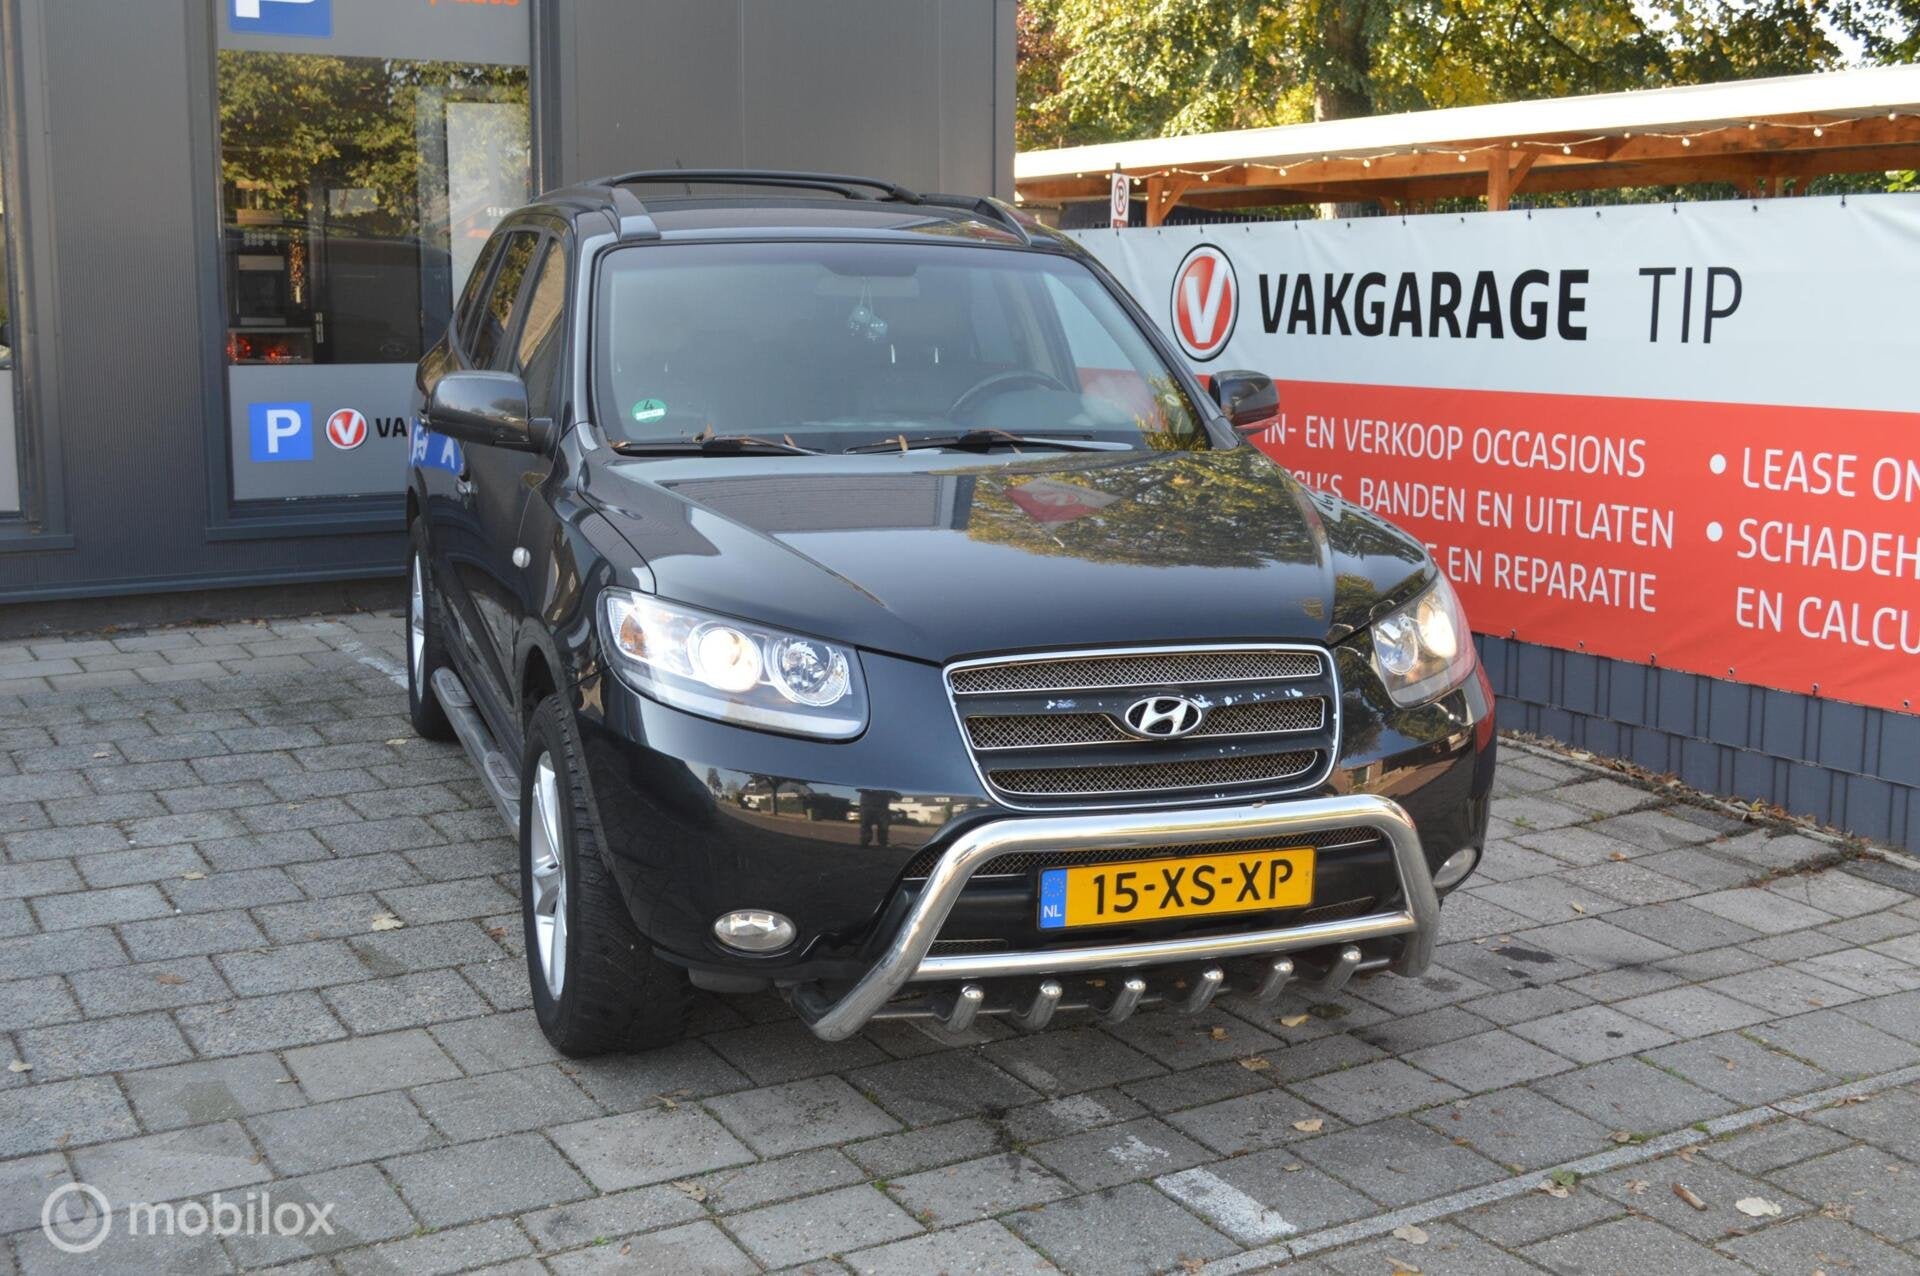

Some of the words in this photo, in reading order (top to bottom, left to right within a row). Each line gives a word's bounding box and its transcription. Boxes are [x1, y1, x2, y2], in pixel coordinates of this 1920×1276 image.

[1258, 268, 1590, 341] VAKGARAGE
[1639, 266, 1743, 344] TIP
[266, 409, 302, 454] P
[375, 417, 408, 438] VA
[1306, 415, 1335, 450] EN
[1343, 418, 1463, 461] VERKOOP
[1472, 428, 1647, 478] OCCASIONS
[1742, 447, 1858, 498] LEASE
[1359, 477, 1466, 523] BANDEN
[1476, 490, 1513, 529] EN
[1525, 497, 1674, 550] UITLATEN
[1448, 546, 1482, 585] EN
[1494, 553, 1657, 613] REPARATIE
[1735, 587, 1783, 633] EN
[1043, 904, 1062, 918] NL
[1093, 858, 1294, 915] 15-XS-XP
